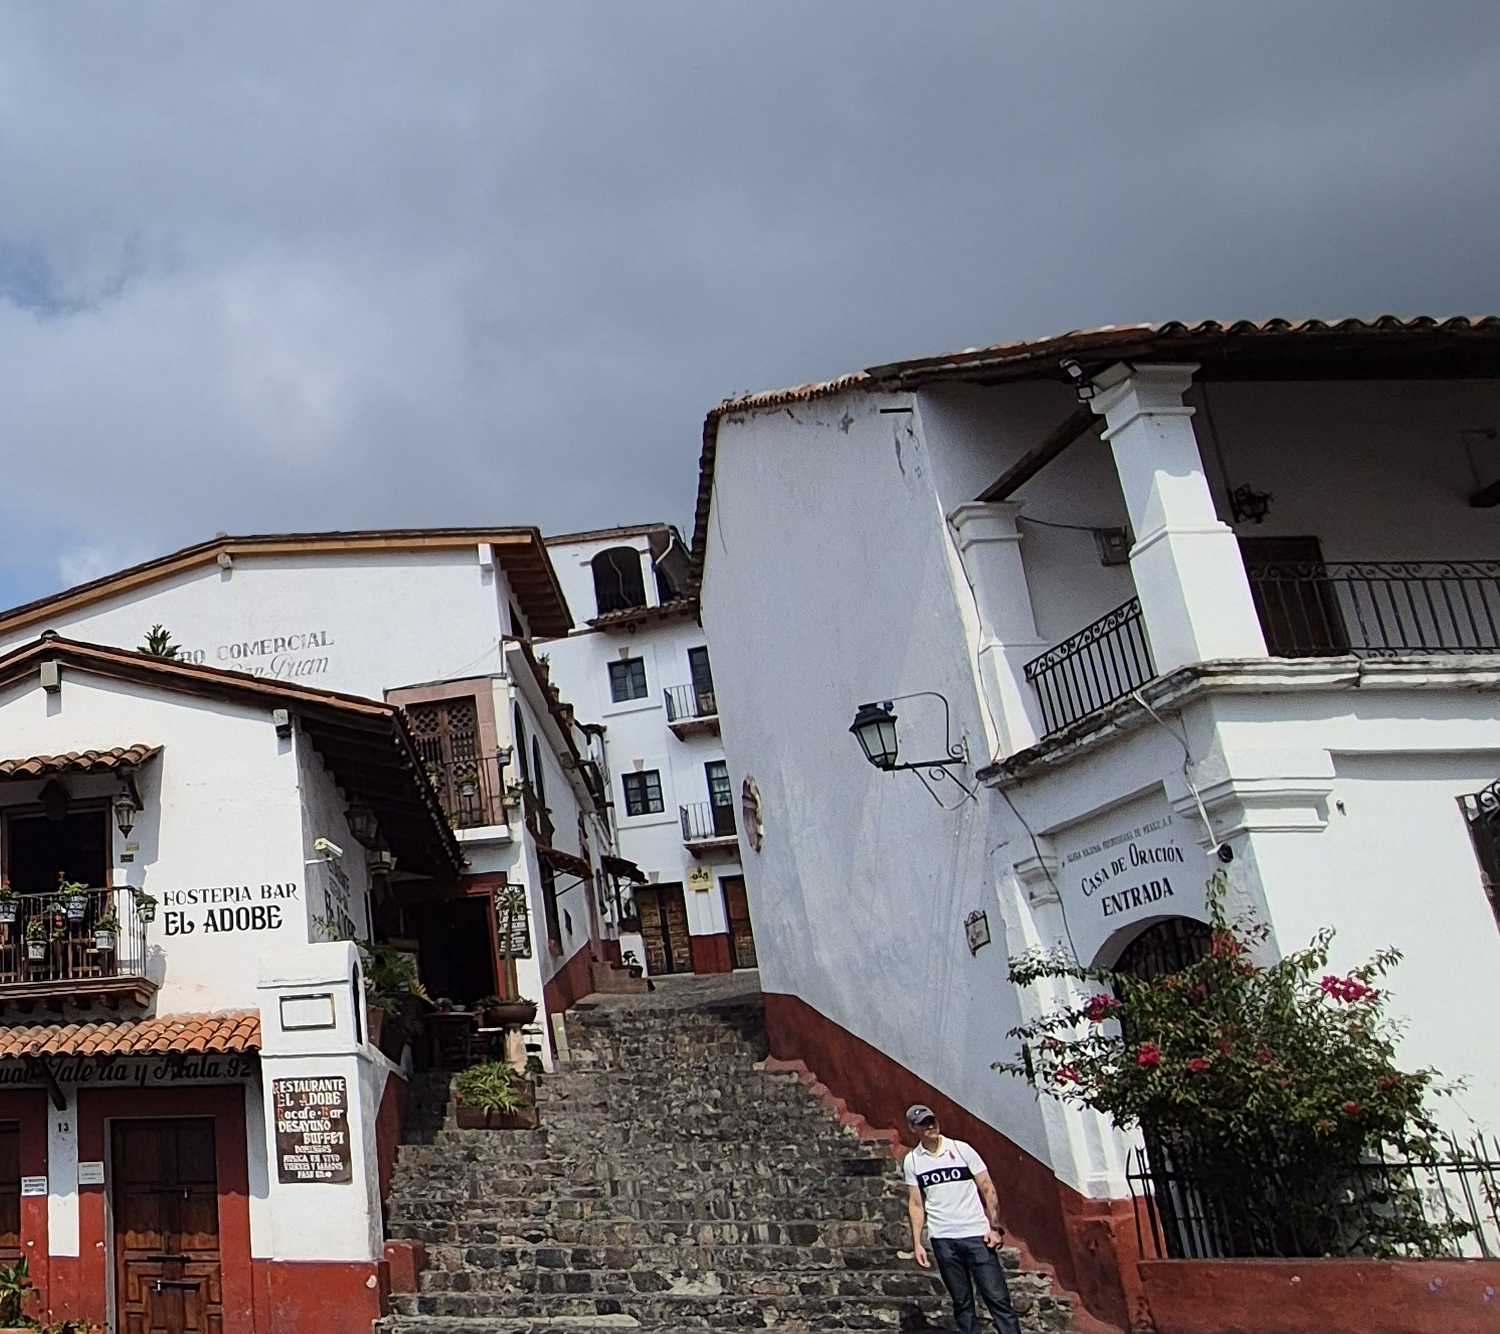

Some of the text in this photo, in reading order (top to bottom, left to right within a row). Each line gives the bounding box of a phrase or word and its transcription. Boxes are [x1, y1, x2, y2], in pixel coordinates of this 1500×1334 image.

[1110, 856, 1127, 876] DE
[163, 882, 299, 906] HOSTERIA BAR
[1101, 877, 1174, 917] ENTRADA
[163, 905, 283, 936] EL ADOBE
[134, 1063, 149, 1086] y
[273, 1079, 345, 1094] RESTAURANTE
[277, 1092, 341, 1107] EL ADOBE
[58, 1122, 69, 1133] 13
[303, 1132, 345, 1145] BUFFET
[921, 1168, 962, 1186] POLO
